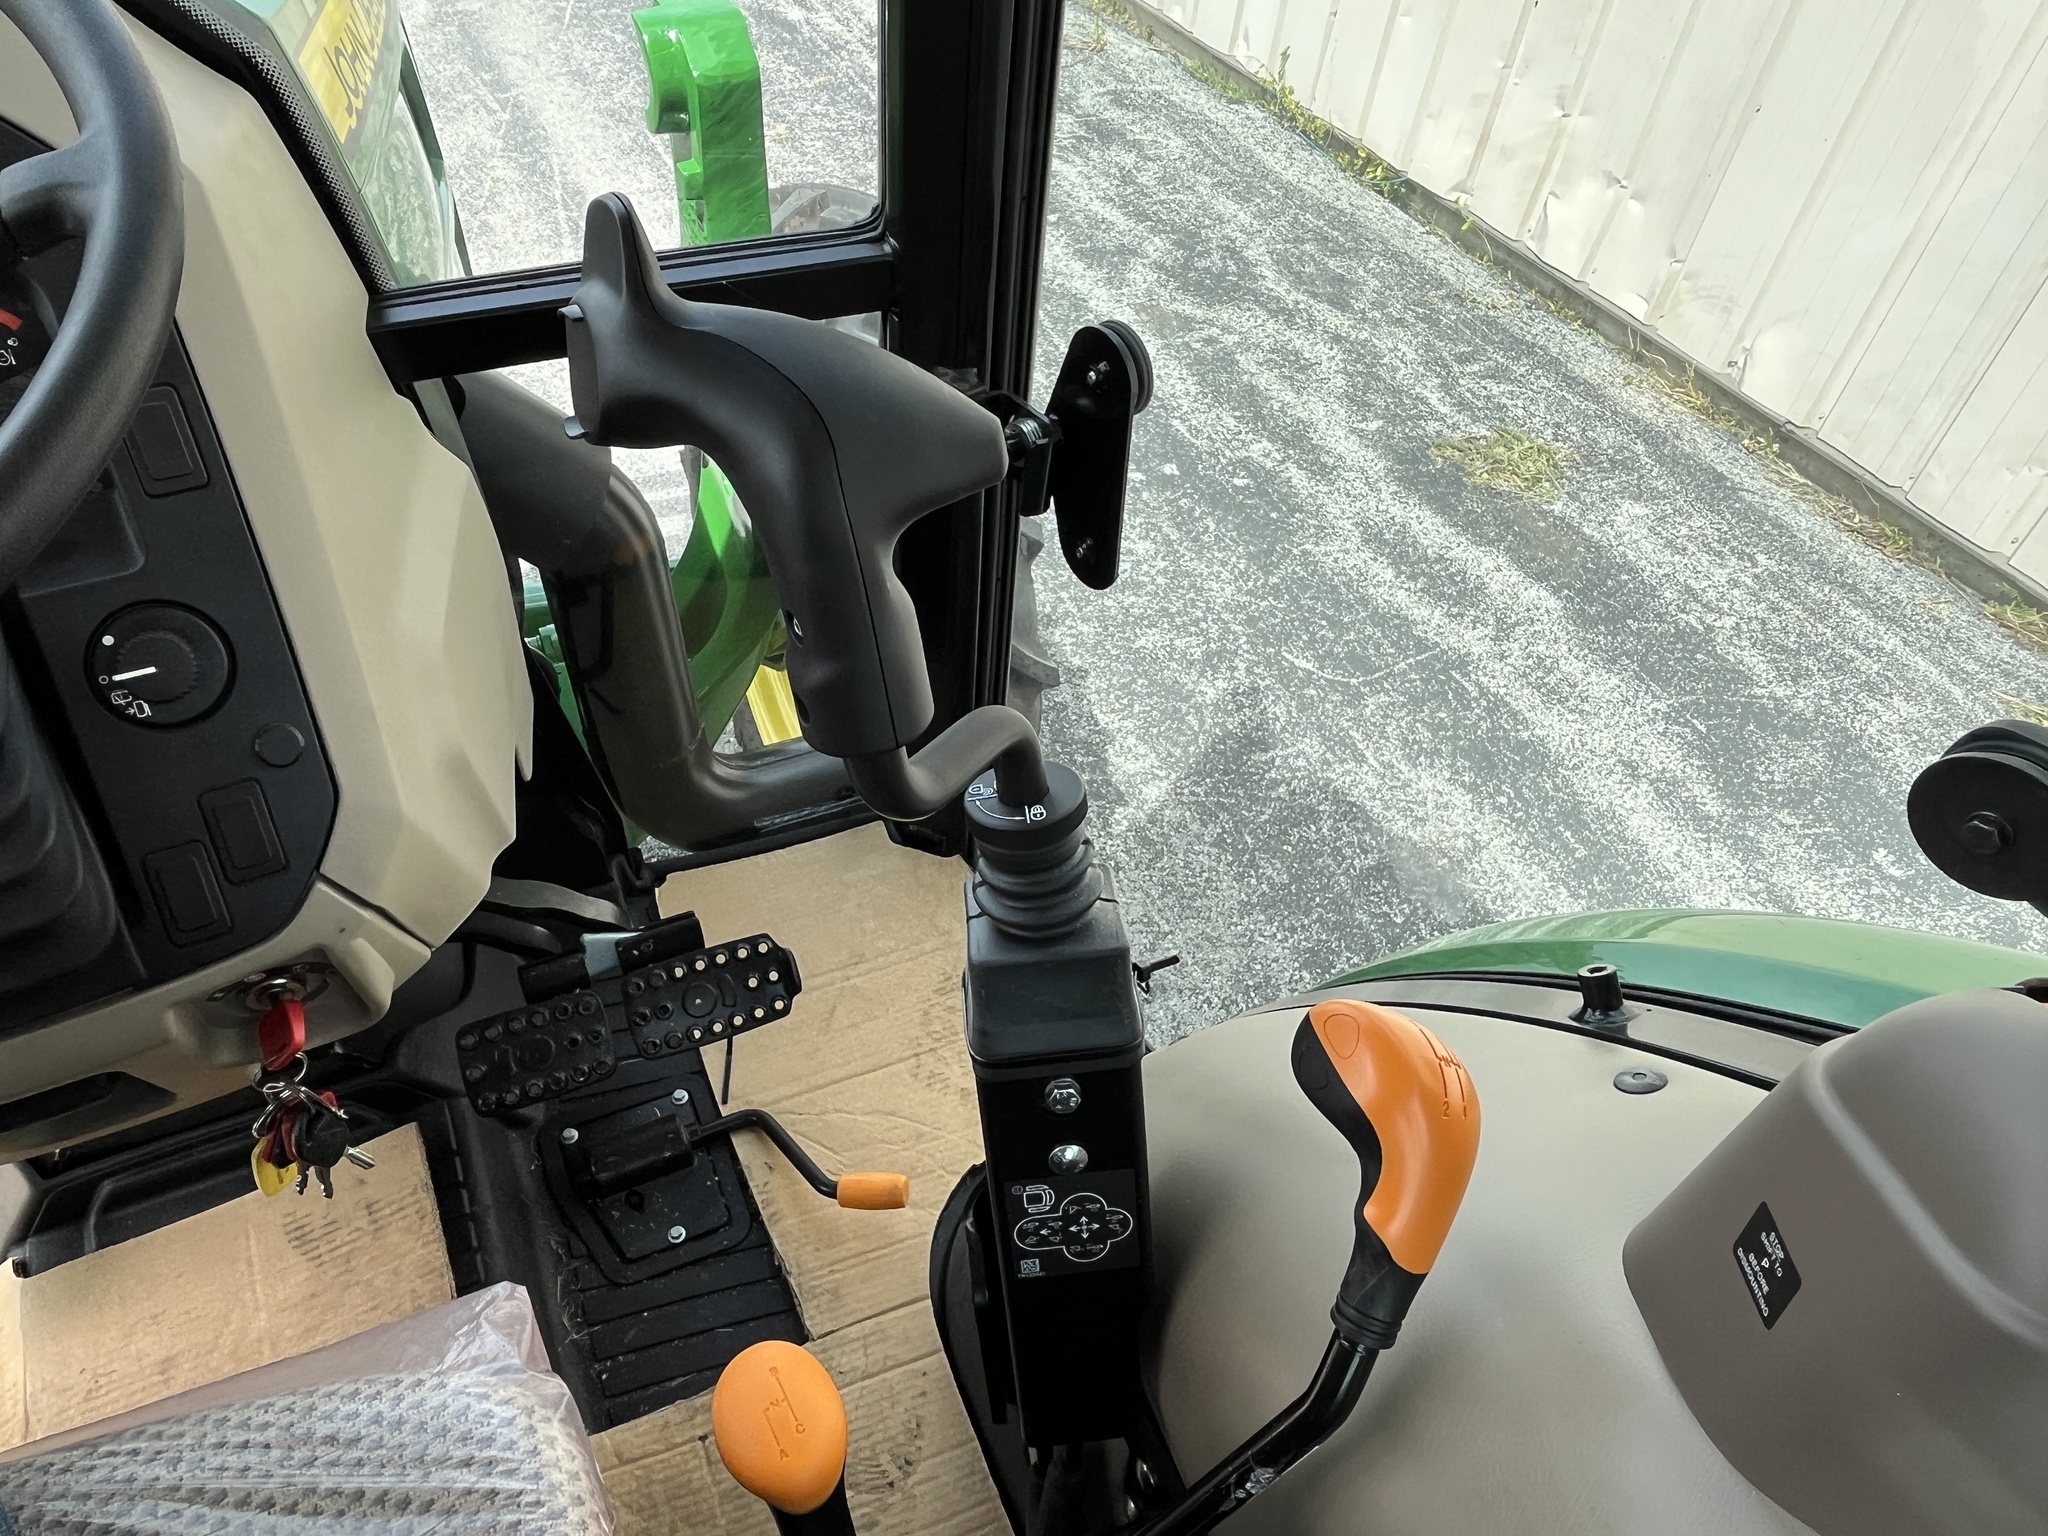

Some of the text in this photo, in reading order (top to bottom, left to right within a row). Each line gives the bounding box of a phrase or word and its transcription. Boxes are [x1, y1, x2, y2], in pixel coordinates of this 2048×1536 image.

[323, 13, 373, 119] JOHN
[1441, 1100, 1450, 1119] 2
[1769, 1231, 1784, 1259] STOP
[1748, 1252, 1770, 1295] BEFORE
[1774, 1261, 1783, 1277] TO
[1737, 1247, 1769, 1317] DISMOUNTING
[795, 1423, 806, 1434] C
[779, 1448, 790, 1461] A
